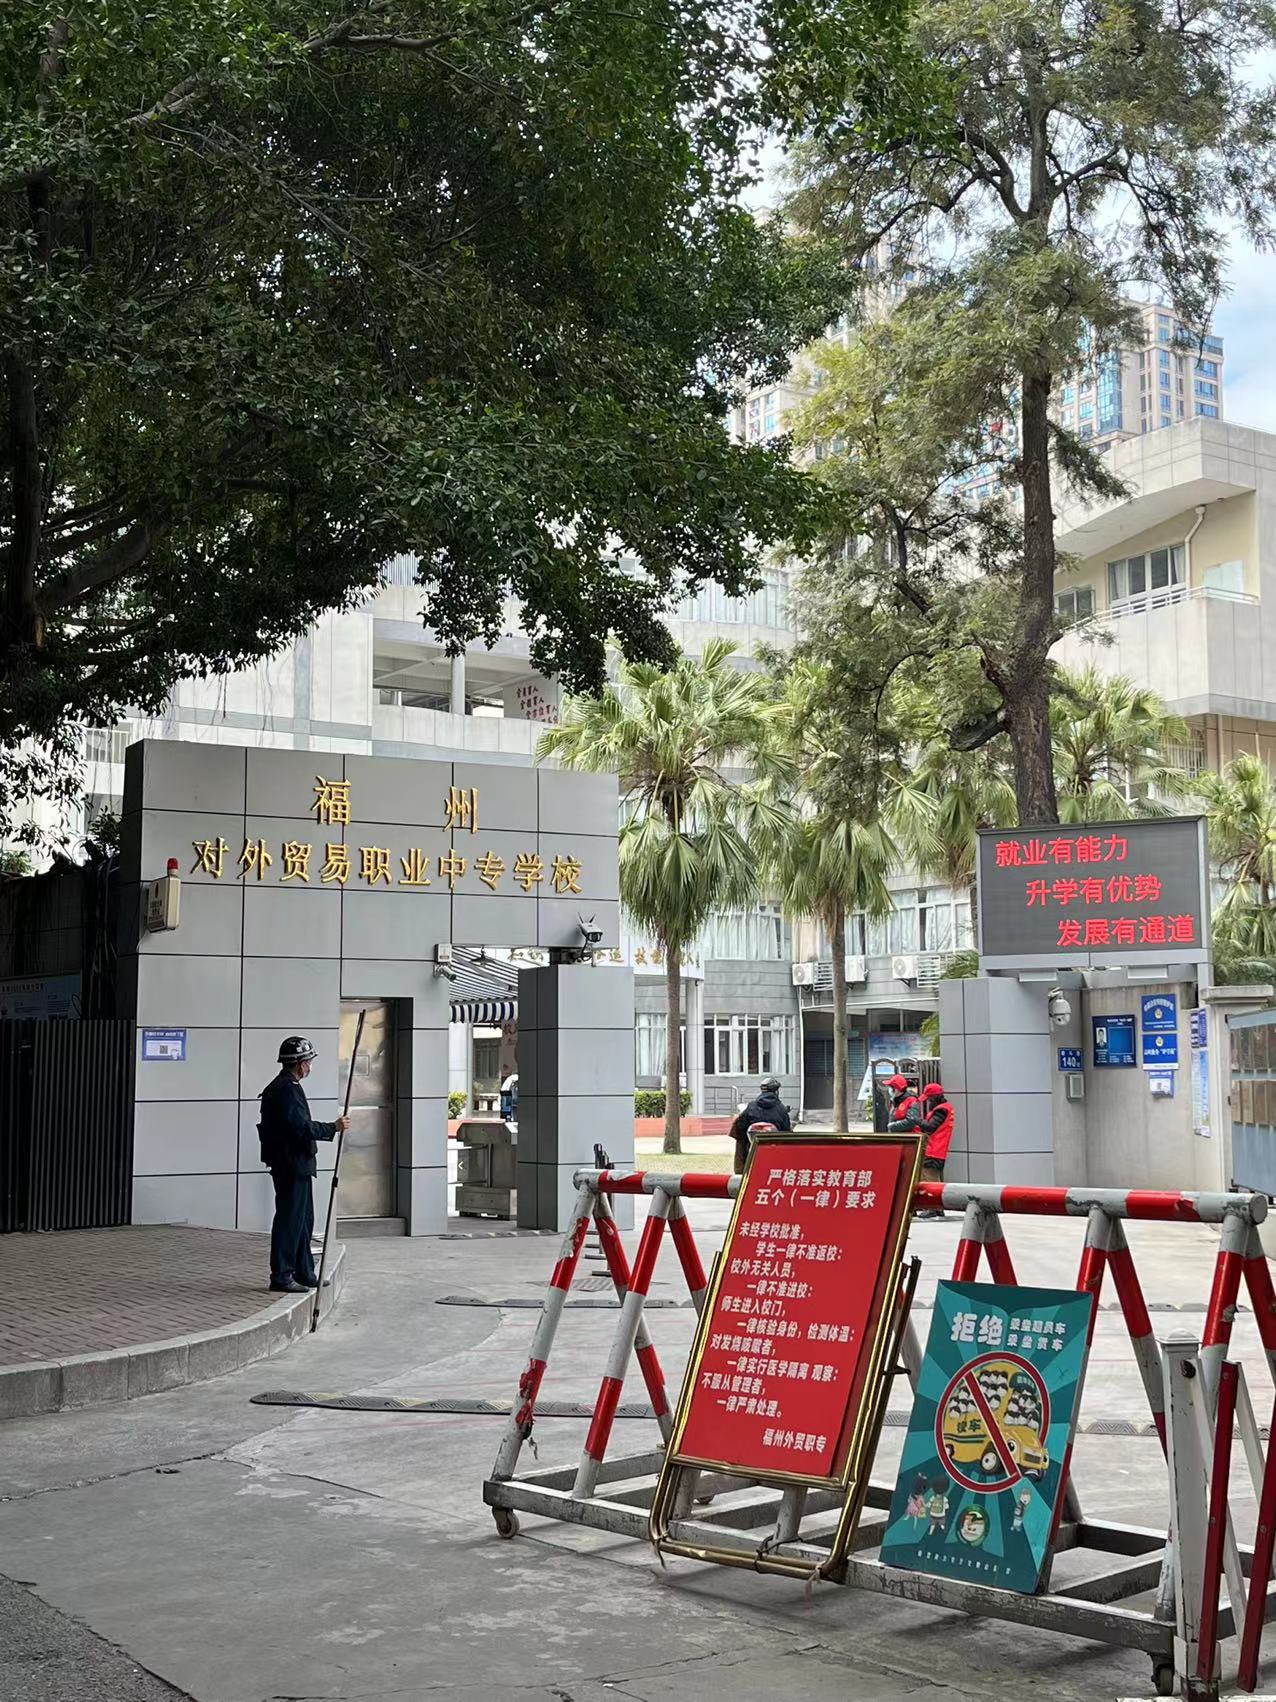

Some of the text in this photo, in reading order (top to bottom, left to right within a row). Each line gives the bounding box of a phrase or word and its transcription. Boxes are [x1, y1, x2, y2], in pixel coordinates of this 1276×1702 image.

[191, 836, 584, 895] 对外贸易职业中专学校
[995, 834, 1128, 867] 就业有能力
[1025, 874, 1162, 907] 升学有优势
[1056, 914, 1196, 948] 发展有通道
[767, 1168, 873, 1188] 严格落实教育部
[950, 1311, 1003, 1346] 拒绝
[762, 1428, 827, 1453] 福州外贸职专
